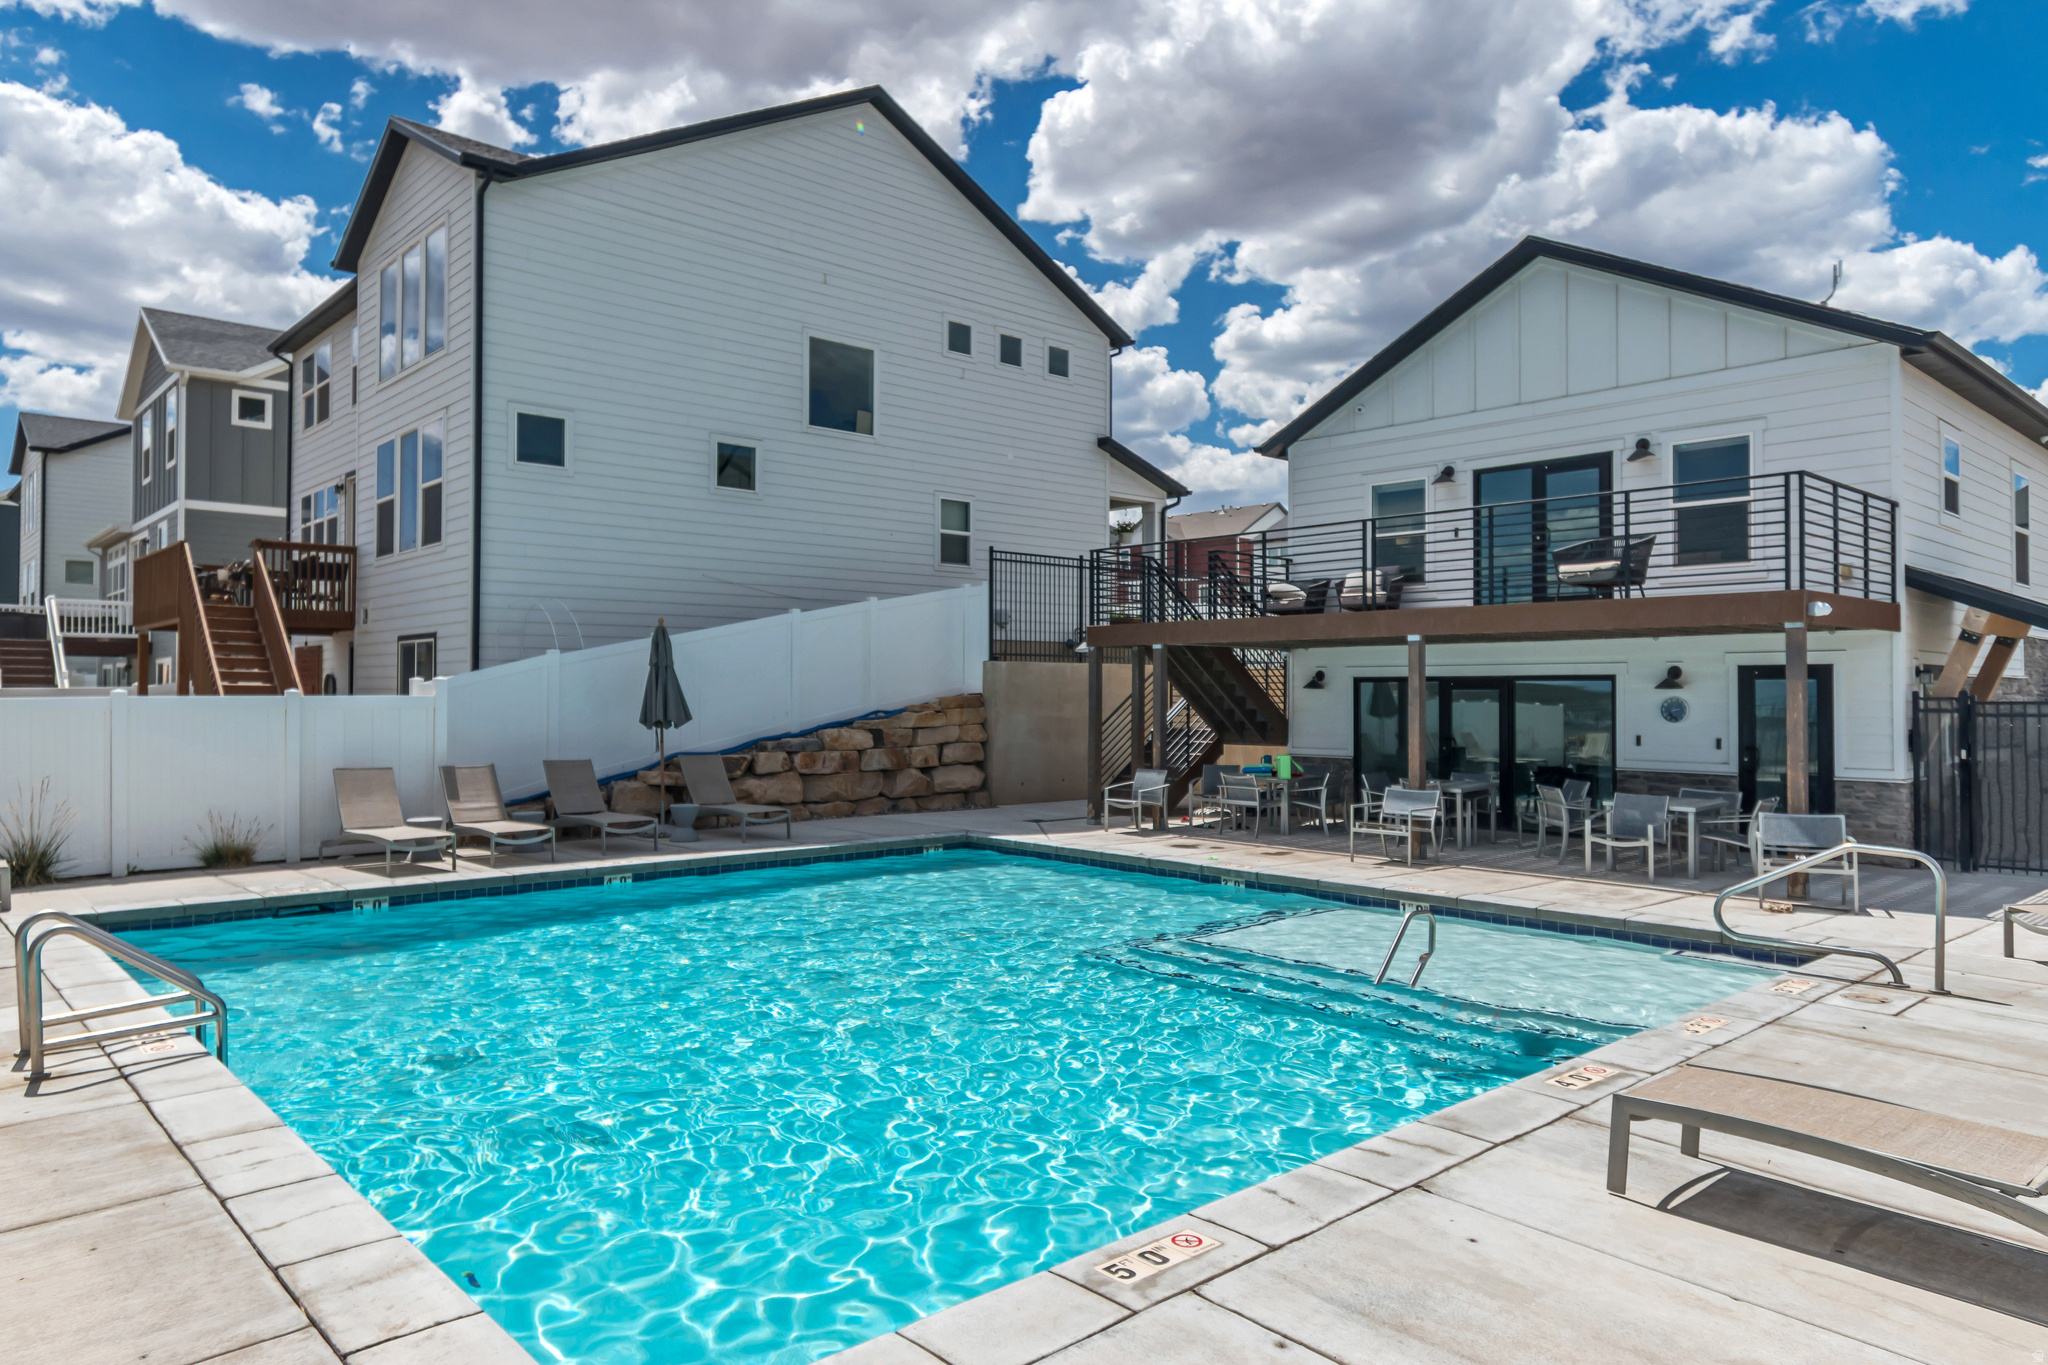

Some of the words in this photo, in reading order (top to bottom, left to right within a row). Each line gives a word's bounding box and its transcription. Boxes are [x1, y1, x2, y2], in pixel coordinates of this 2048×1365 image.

[355, 901, 363, 909] 5
[1151, 1245, 1167, 1253] IN
[1118, 1258, 1134, 1267] FT
[1137, 1250, 1171, 1266] 0
[1102, 1263, 1137, 1280] 5
